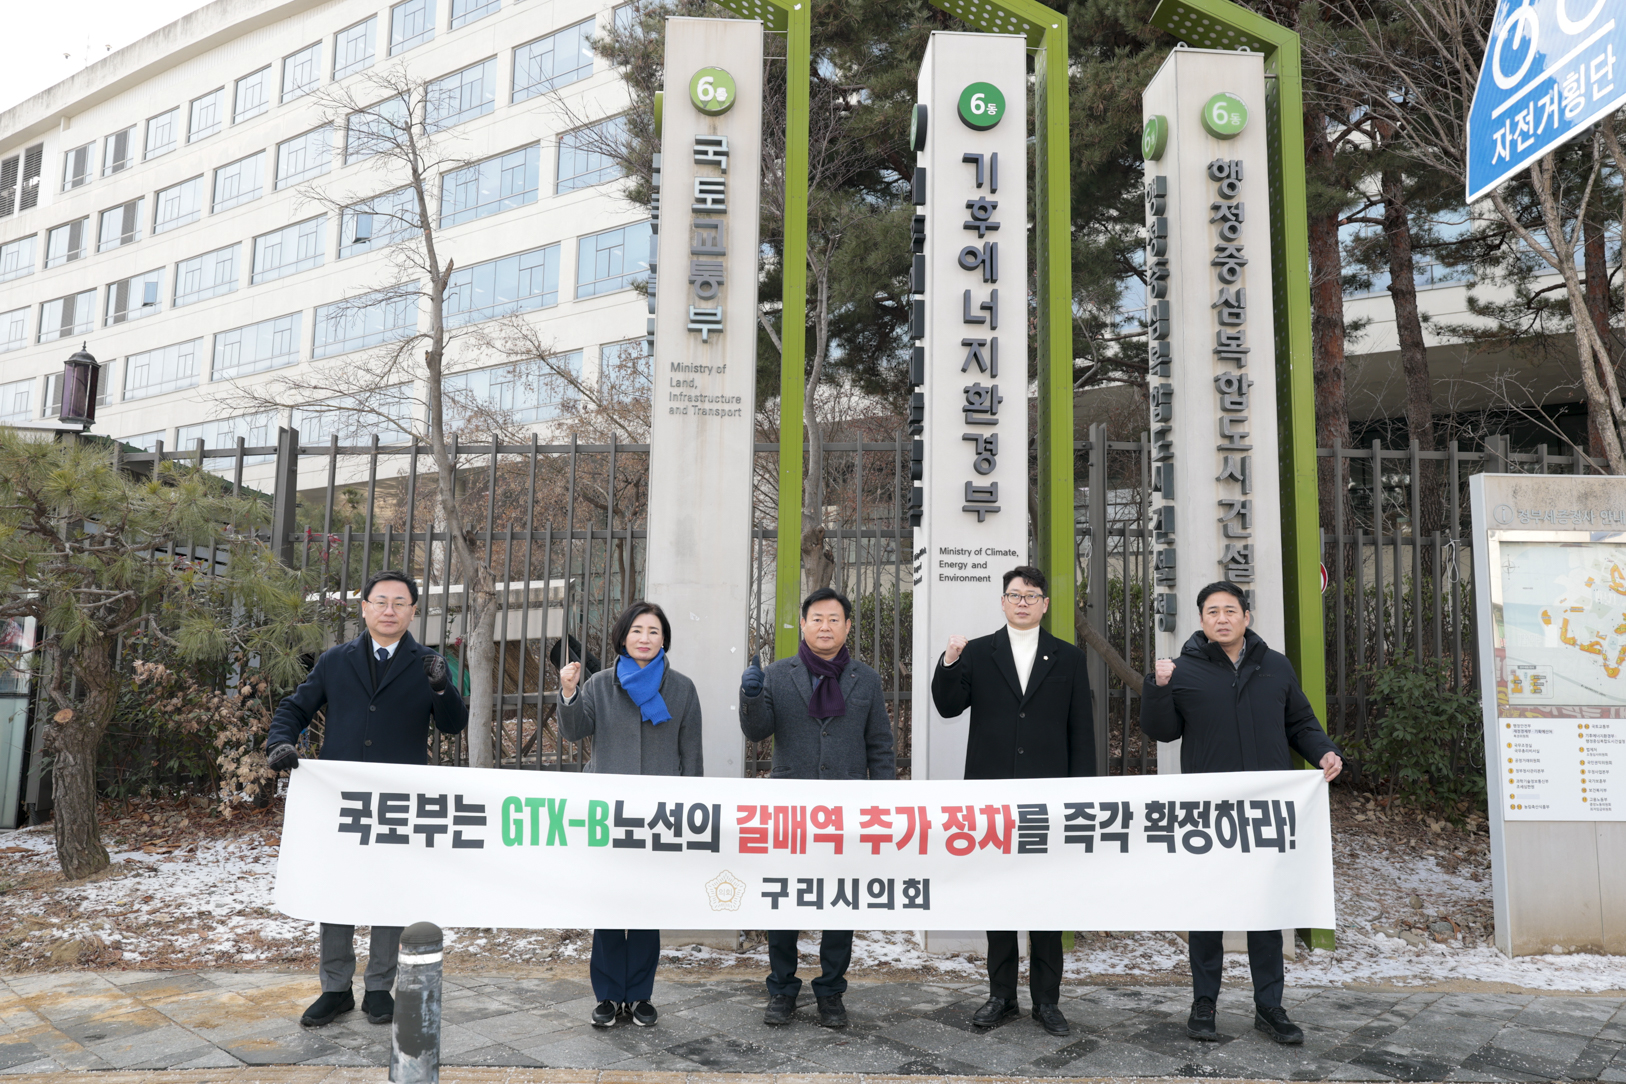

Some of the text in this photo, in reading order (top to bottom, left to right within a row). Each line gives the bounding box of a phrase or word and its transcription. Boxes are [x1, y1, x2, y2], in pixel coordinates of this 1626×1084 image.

[970, 93, 998, 115] 6동
[1491, 43, 1617, 165] 자전거횡단
[1212, 102, 1242, 126] 6동
[687, 134, 729, 343] 국토교통부
[958, 152, 1003, 523] 기후에너지환경부
[670, 362, 727, 376] Ministry of
[670, 377, 698, 389] Land,
[669, 391, 742, 404] Infrastructure
[669, 405, 742, 418] and Transport
[1517, 509, 1595, 525] 정부세종청사
[939, 547, 1019, 558] Ministry of Climate,
[939, 560, 987, 570] Energy and
[939, 573, 991, 582] Environment
[338, 790, 1297, 856] 국토부는 GTX-B노선의 갈매역 추가 정차를 즉각 확정하라!
[761, 877, 931, 910] 구리시의회
